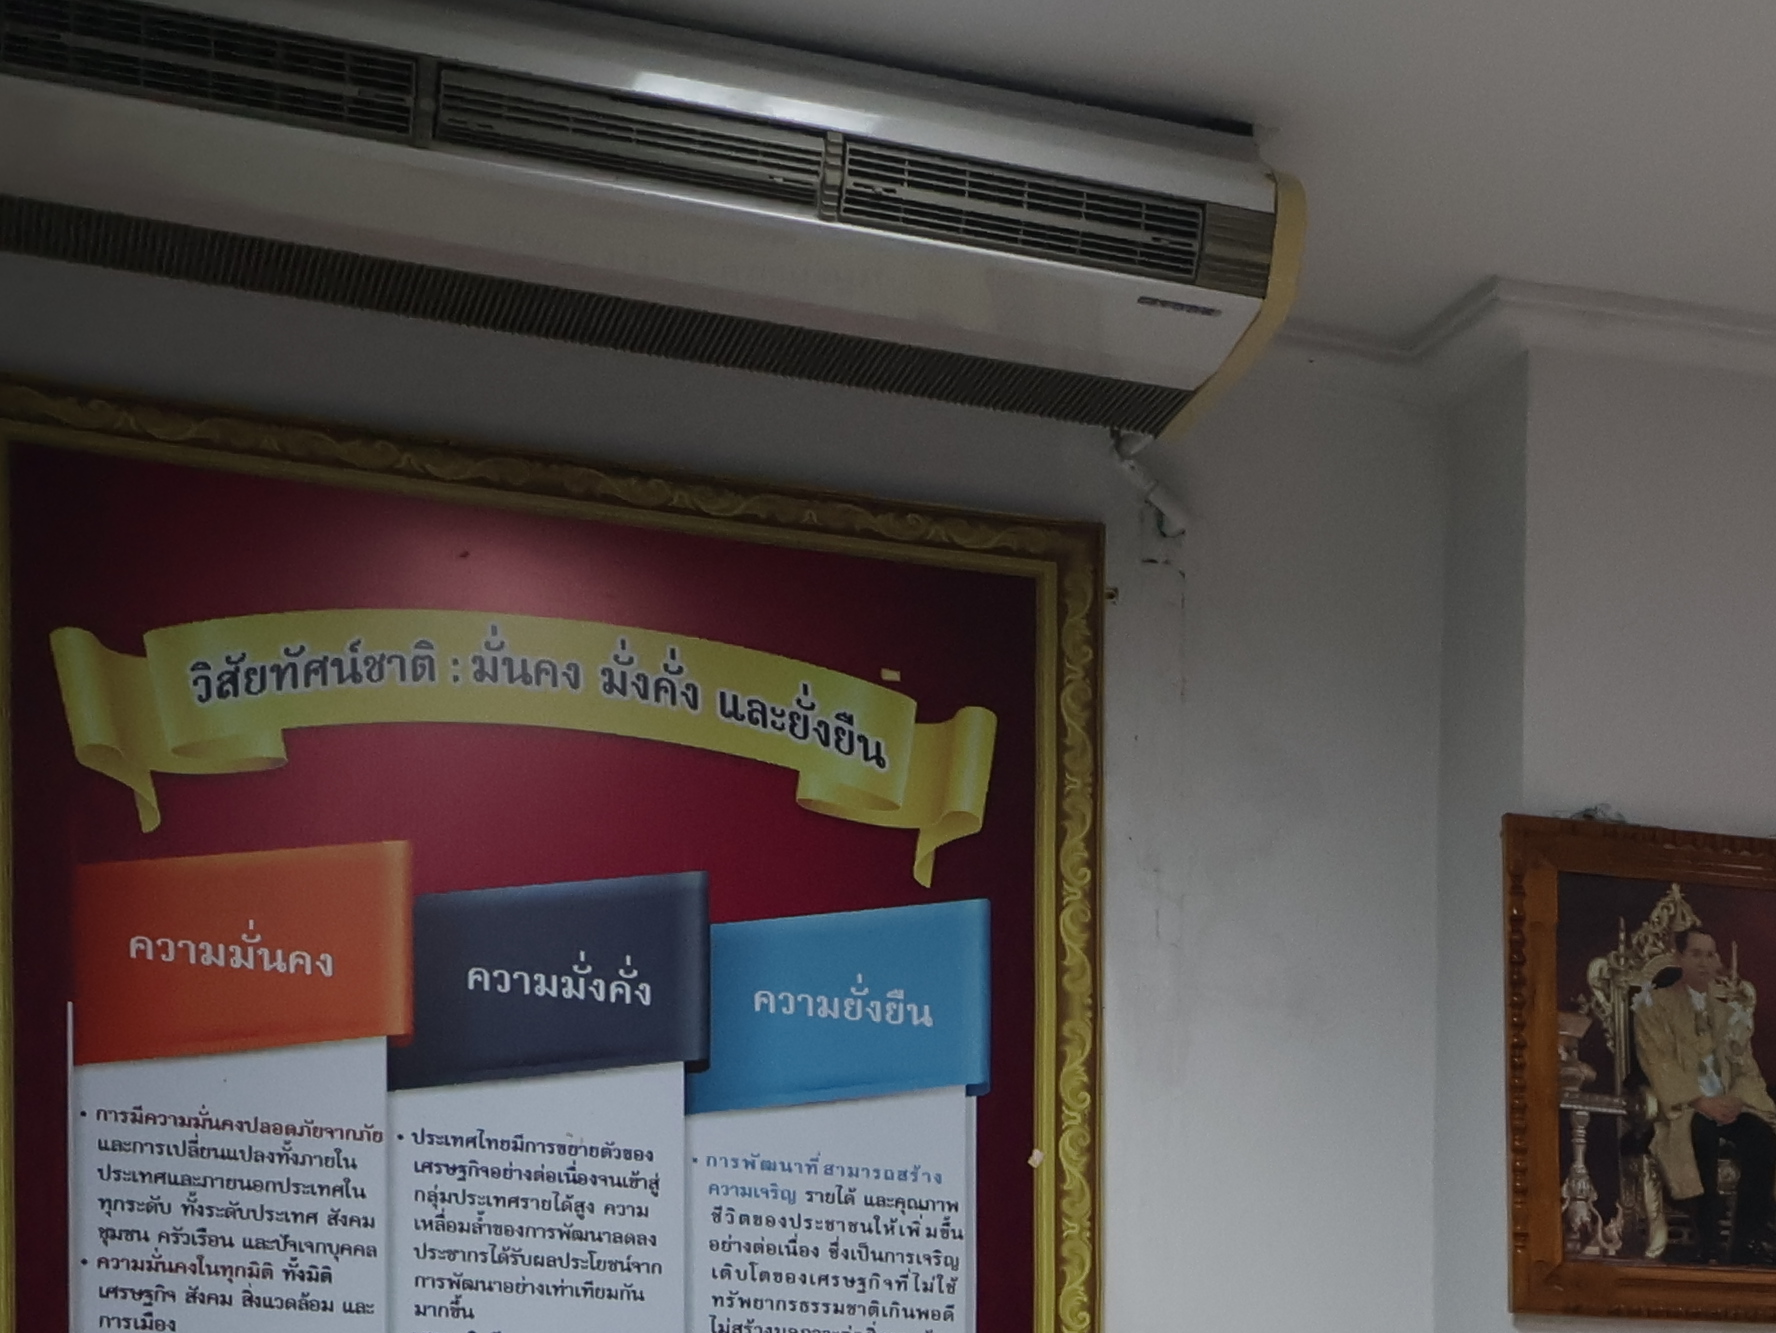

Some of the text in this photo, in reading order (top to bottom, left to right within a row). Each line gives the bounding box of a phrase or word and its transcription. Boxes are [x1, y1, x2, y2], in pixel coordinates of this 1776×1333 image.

[191, 636, 436, 706] วิสัยทัศน์ชาติ
[471, 626, 582, 690] มั่นคง
[599, 638, 703, 712] มั่งคั่ง
[717, 683, 887, 772] และยั่งยืน
[129, 919, 335, 978] ความมั่นคง
[466, 952, 653, 1007] ความมั่งคั่ง
[752, 975, 934, 1028] ความยั่งยืน
[96, 1105, 384, 1143] การมีความมั่นคงปลอดภัยจากภัย
[98, 1133, 357, 1171] และการเปลี่ยนแปลงทั้งภายใน
[411, 1128, 654, 1162] ประเทศไทยมีการขยายตัวของ
[98, 1164, 366, 1200] ประเทศและภายนอกประเทศใน
[709, 1183, 958, 1215] ความเจริญ รายได้ และคุณภาพ
[98, 1192, 375, 1228] ทุกระดับ ทั้งระดับประเทศ สังคม
[604, 1203, 649, 1218] ความ
[98, 1226, 149, 1249] ชุมชน
[158, 1227, 234, 1249] ครัวเรือน
[96, 1248, 274, 1283] ความมั่นคงในทุกมิติ
[98, 1284, 176, 1307] เศรษฐกิจ
[185, 1285, 233, 1306] สังคม
[342, 1300, 375, 1315] และ
[98, 1302, 176, 1332] การเมือง
[414, 1295, 474, 1320] มากขึ้น
